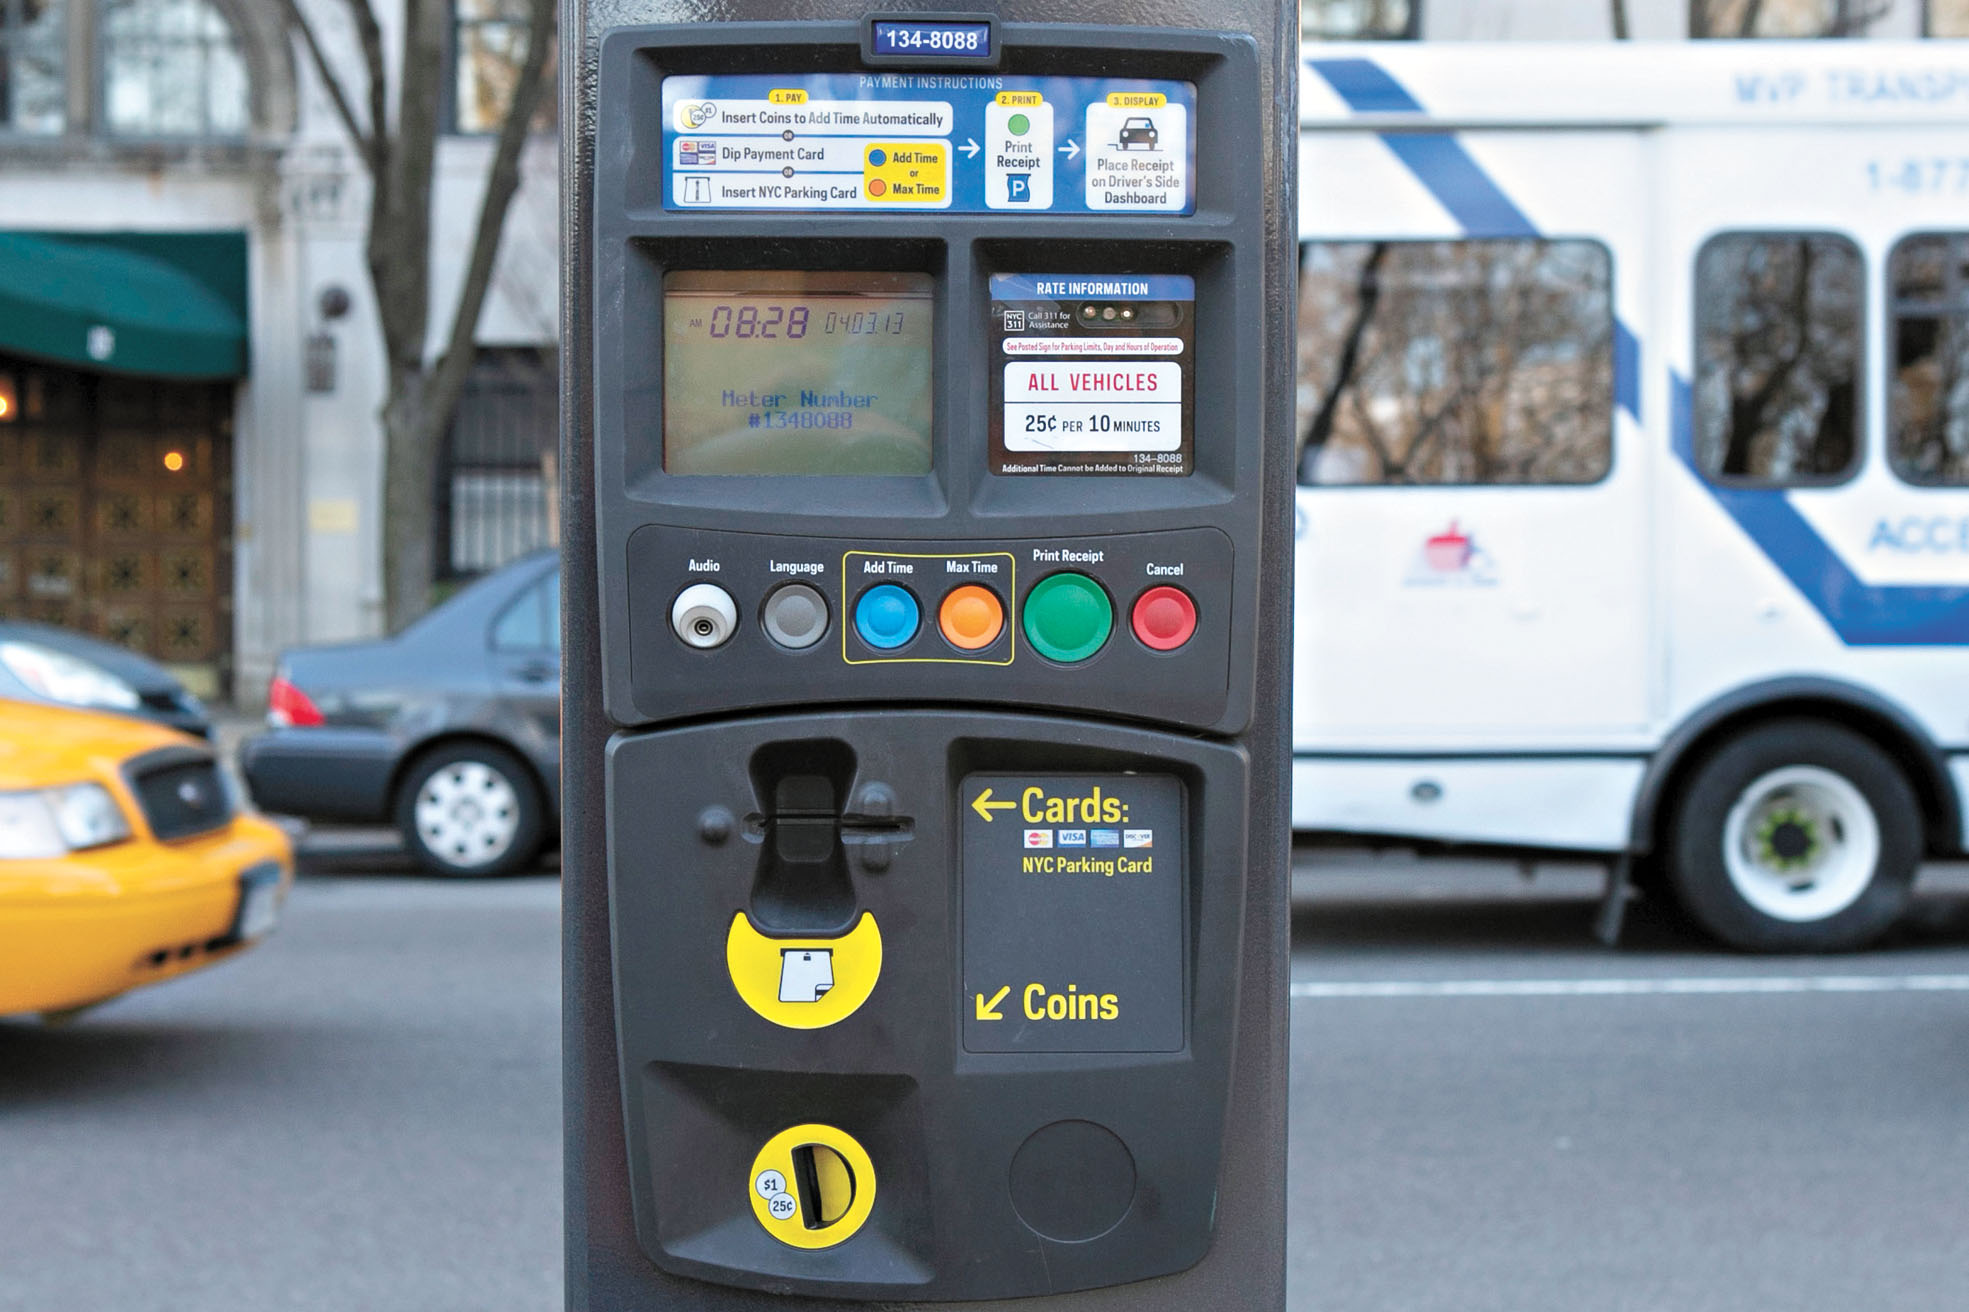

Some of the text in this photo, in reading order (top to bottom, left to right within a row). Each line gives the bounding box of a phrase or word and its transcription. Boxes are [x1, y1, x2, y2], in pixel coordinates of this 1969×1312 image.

[886, 30, 978, 50] 134-8088
[859, 76, 1003, 90] PAYMENT INSTRUCTIONS
[1735, 75, 1804, 102] MVP
[786, 93, 802, 102] PAY
[1001, 95, 1037, 105] 2. PRINT
[1113, 96, 1159, 106] 3. DISPLAY
[722, 111, 943, 128] Insert Coins to Add Time Automatically
[1005, 141, 1032, 153] Print
[722, 148, 824, 163] Dip Payment Card
[893, 153, 938, 164] Add Time
[997, 156, 1040, 171] Receipt
[1097, 159, 1174, 175] Place Receipt
[909, 169, 919, 178] or
[1092, 176, 1179, 189] on Driver's Side
[722, 186, 857, 202] Insert NYC Parking Card
[893, 184, 940, 195] Max Time
[1105, 192, 1167, 205] Dashboard
[1037, 283, 1149, 296] RATE INFORMATION
[689, 318, 702, 328] AM
[710, 306, 810, 339] 08:28
[1028, 312, 1071, 320] Call 311 for
[1007, 320, 1022, 329] 311
[1029, 321, 1069, 329] Assistance
[1007, 342, 1017, 351] See
[1018, 342, 1038, 351] Posted
[1039, 342, 1052, 353] Sign
[1052, 342, 1060, 351] for
[1061, 342, 1083, 353] Parking
[1103, 342, 1114, 353] Day
[1115, 342, 1126, 351] and
[1127, 342, 1143, 351] Hours
[1144, 342, 1150, 351] of
[1150, 342, 1178, 352] Operation
[1028, 374, 1158, 391] ALL VEHICLES
[722, 390, 878, 408] Meter Number
[748, 412, 852, 429] #1348088
[1025, 414, 1161, 433] 25¢ PER 10 MINUTES
[1134, 454, 1183, 463] 134-8088
[1002, 464, 1183, 474] Additional Time Cannot be Added to Original Receipt
[1033, 550, 1104, 564] Print Receipt
[689, 559, 720, 572] Audio
[770, 560, 824, 575] Language
[864, 561, 914, 574] Add Time
[946, 561, 998, 573] Max Time
[1146, 563, 1184, 576] Cancel
[1022, 786, 1129, 823] Cards:
[1062, 832, 1085, 841] VISA
[1023, 856, 1153, 876] NYC Parking Card
[1023, 983, 1119, 1020] Coins
[764, 1179, 778, 1191] $1
[773, 1200, 792, 1212] 25¢
